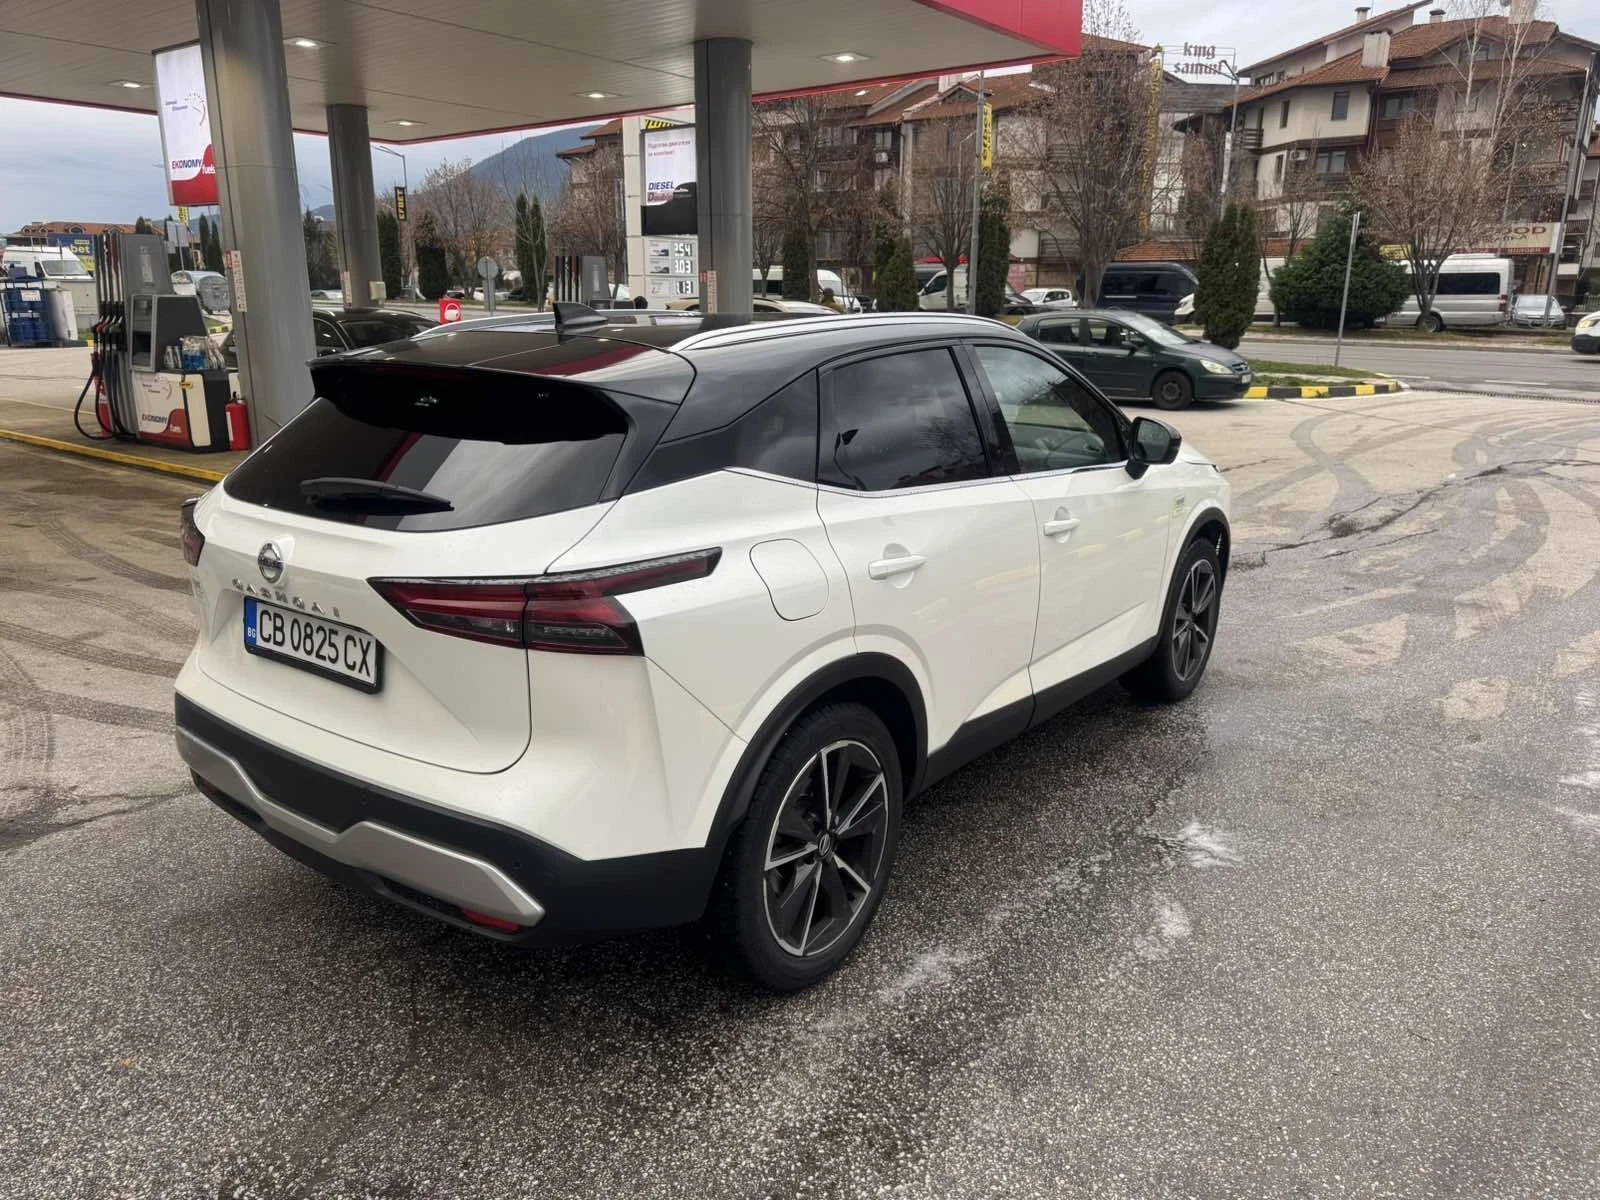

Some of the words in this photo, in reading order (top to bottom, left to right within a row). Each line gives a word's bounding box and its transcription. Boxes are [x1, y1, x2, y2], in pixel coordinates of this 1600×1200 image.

[172, 159, 202, 169] EKONOMY
[648, 181, 675, 191] DIESEL
[232, 576, 340, 618] QASHQAI
[247, 627, 257, 639] BG
[260, 609, 286, 647] CB
[290, 617, 340, 664] 0825
[344, 634, 371, 677] CX
